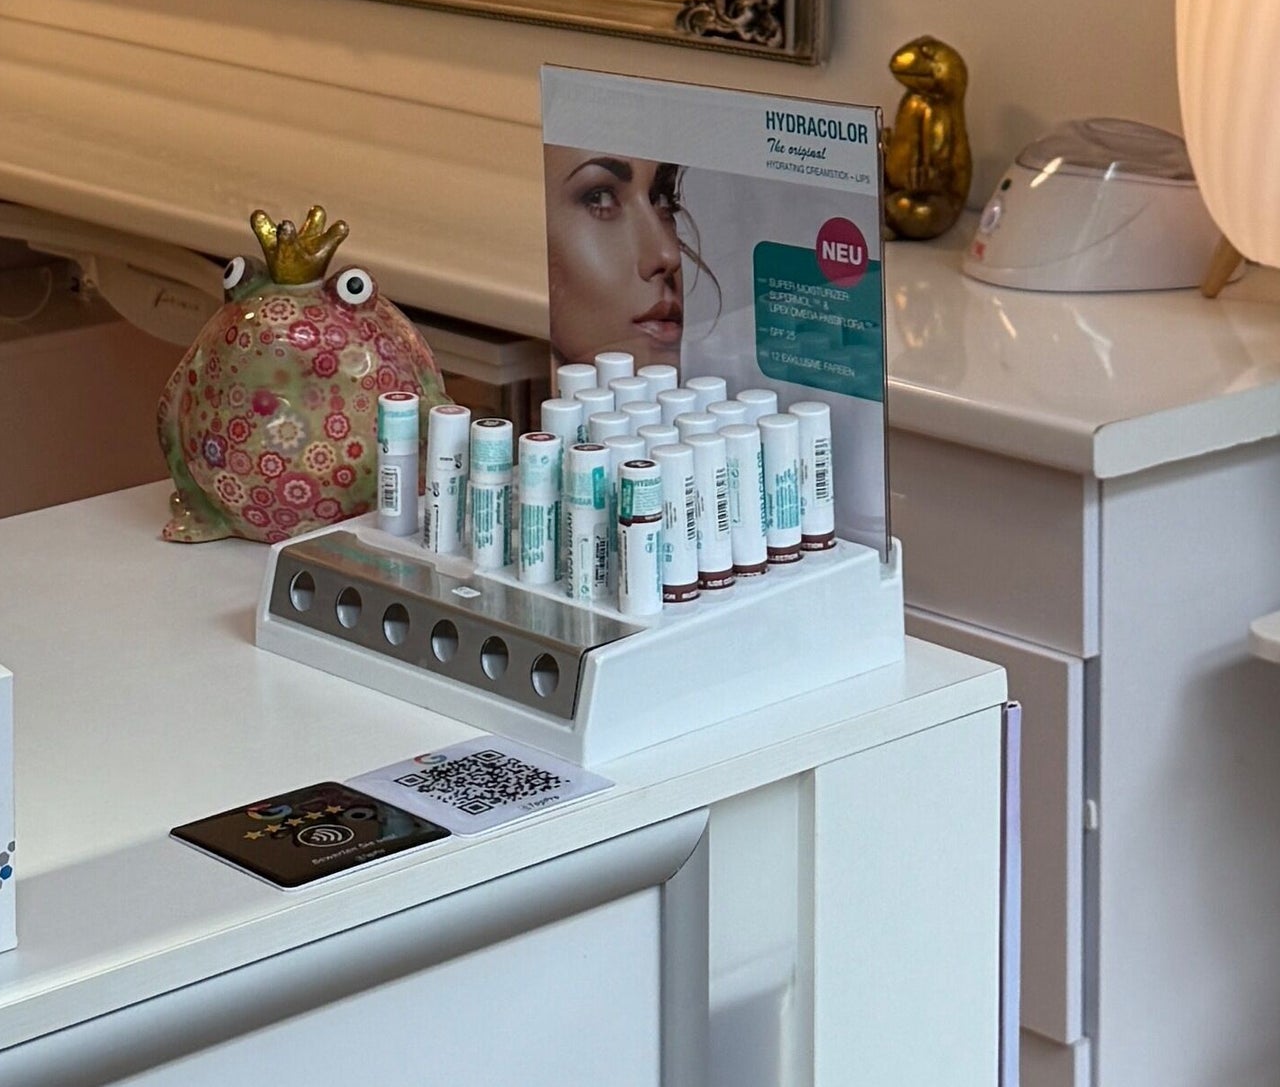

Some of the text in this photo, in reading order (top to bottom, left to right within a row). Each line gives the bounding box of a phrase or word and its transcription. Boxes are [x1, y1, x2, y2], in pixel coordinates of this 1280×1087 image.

[766, 110, 868, 144] HYDRACOLOR
[767, 137, 827, 161] The original
[821, 240, 863, 266] NEU
